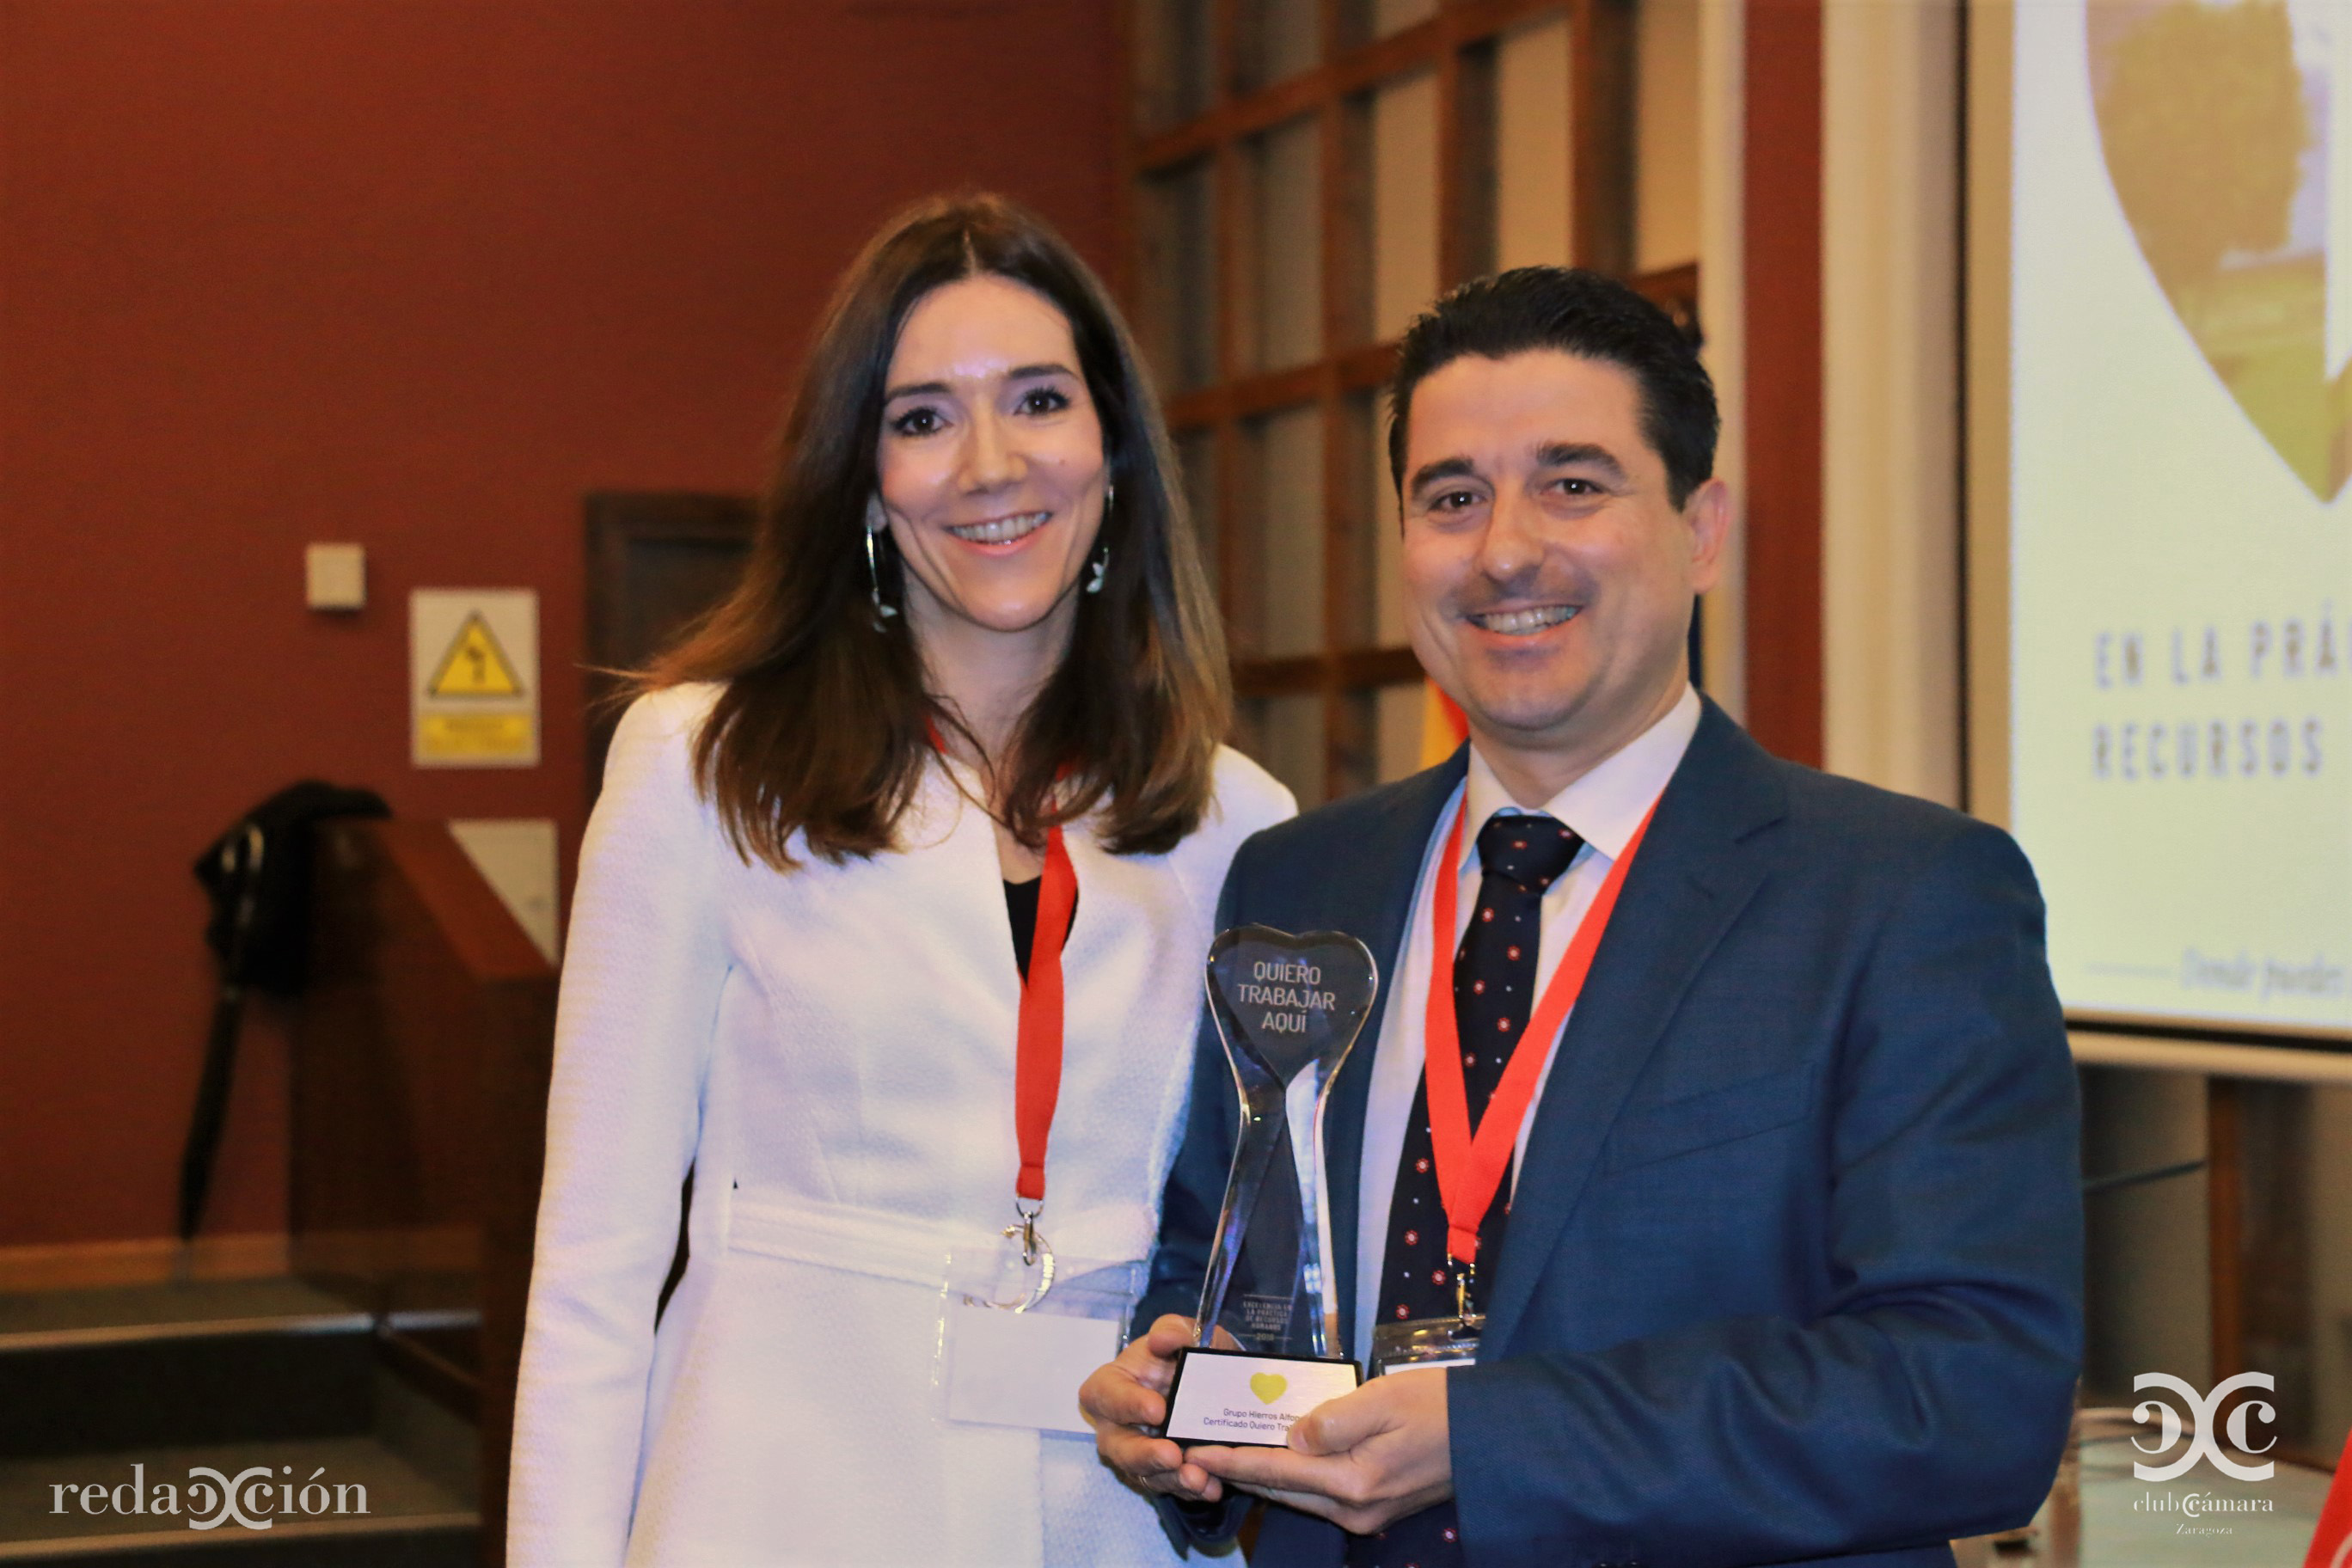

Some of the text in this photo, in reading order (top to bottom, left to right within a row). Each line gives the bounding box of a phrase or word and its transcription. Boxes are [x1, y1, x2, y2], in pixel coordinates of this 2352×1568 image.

[2095, 598, 2352, 690] EN LA PRÁ
[2092, 715, 2324, 781] RECURSOS
[1253, 961, 1321, 986] QUIERO
[1237, 983, 1336, 1011] TRABAJAR
[1261, 1010, 1308, 1033] AQUÍ
[1204, 1417, 1293, 1432] Certificado Quiero Tra
[1223, 1408, 1247, 1418] Grupo
[1249, 1410, 1277, 1421] Hierros
